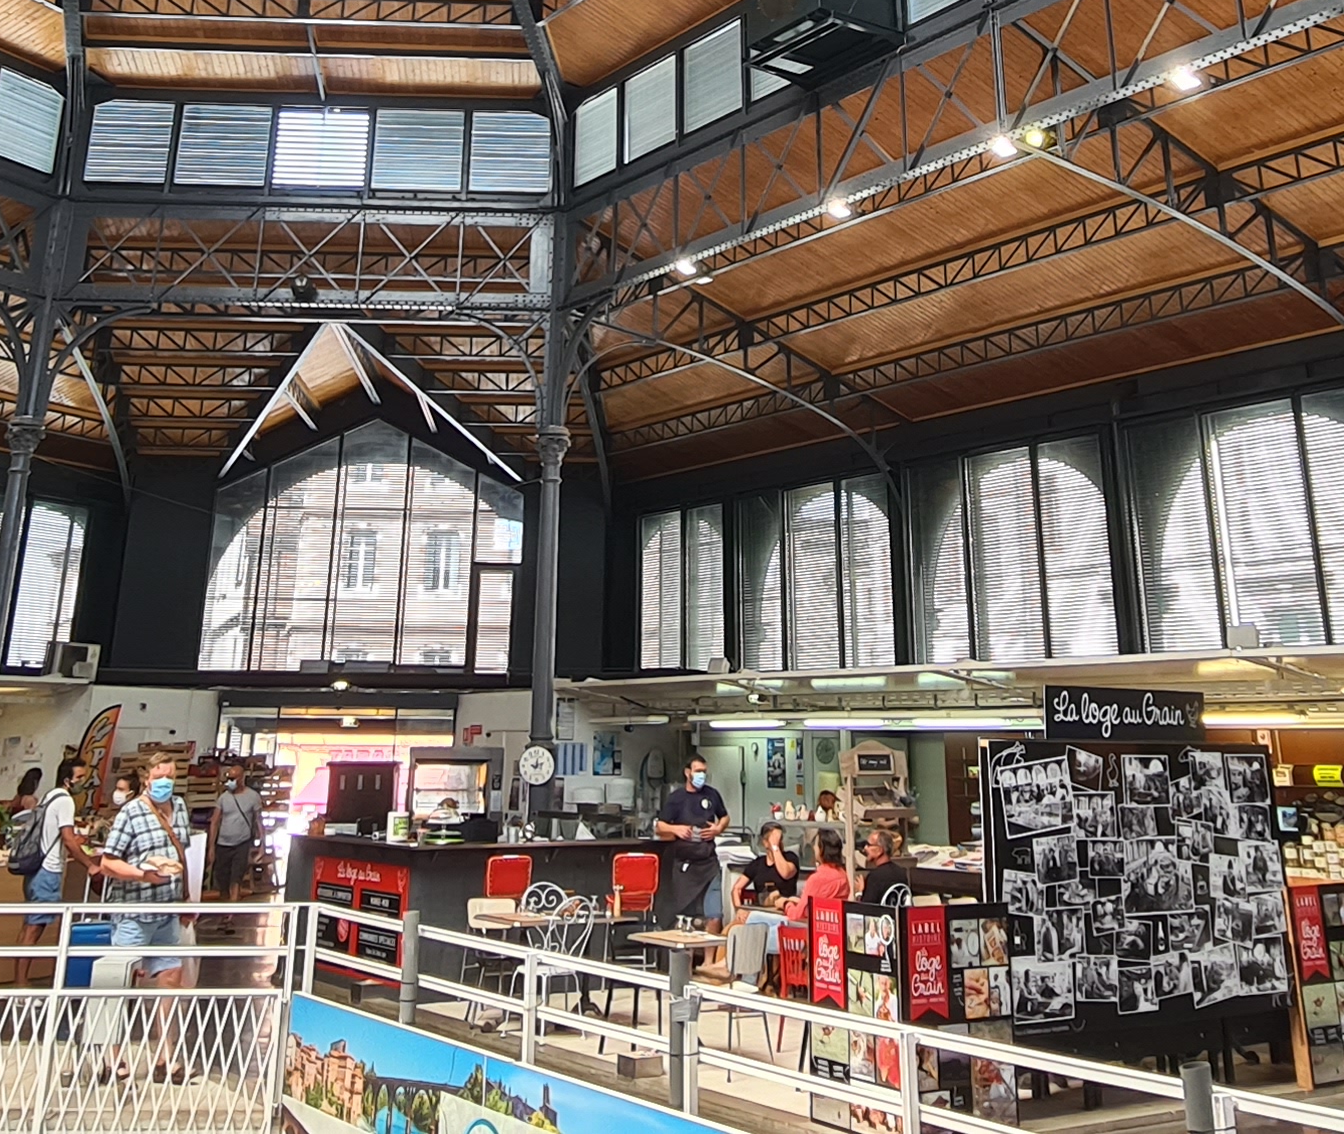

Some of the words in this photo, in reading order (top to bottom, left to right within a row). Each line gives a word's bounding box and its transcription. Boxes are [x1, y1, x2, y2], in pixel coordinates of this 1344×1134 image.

[1053, 690, 1079, 722] La
[1081, 692, 1121, 738] loge
[1122, 707, 1142, 724] au
[1142, 692, 1185, 726] Grain
[915, 950, 942, 981] loge
[912, 973, 944, 997] Grain
